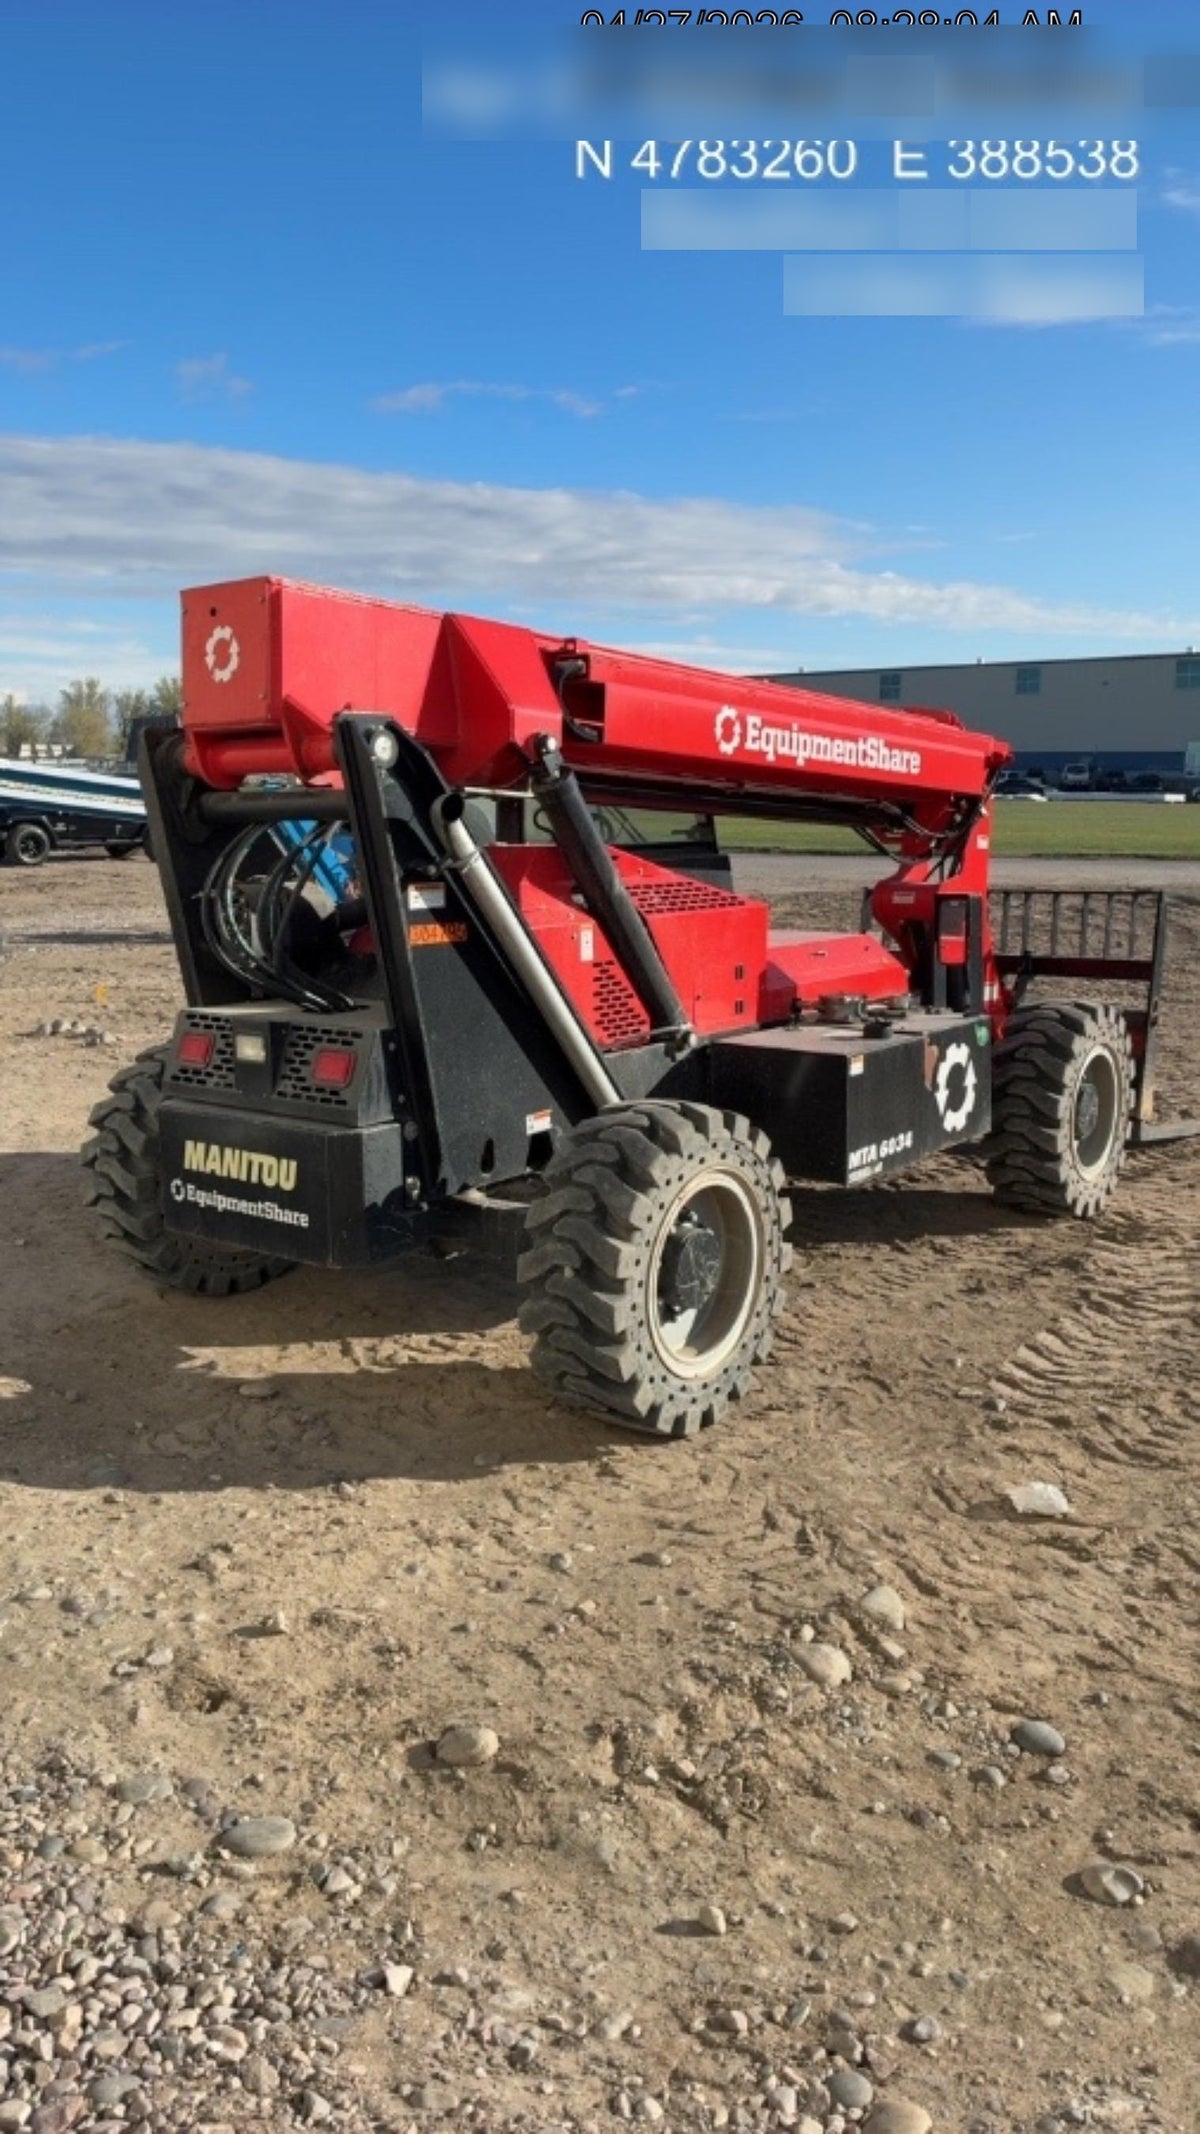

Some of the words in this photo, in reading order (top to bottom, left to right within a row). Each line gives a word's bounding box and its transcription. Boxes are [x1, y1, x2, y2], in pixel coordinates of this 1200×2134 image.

[744, 714, 922, 775] EquipmentShare
[184, 1139, 298, 1192] MANITOU
[848, 1143, 878, 1171] MTA
[186, 1183, 310, 1229] EquipmentShare
